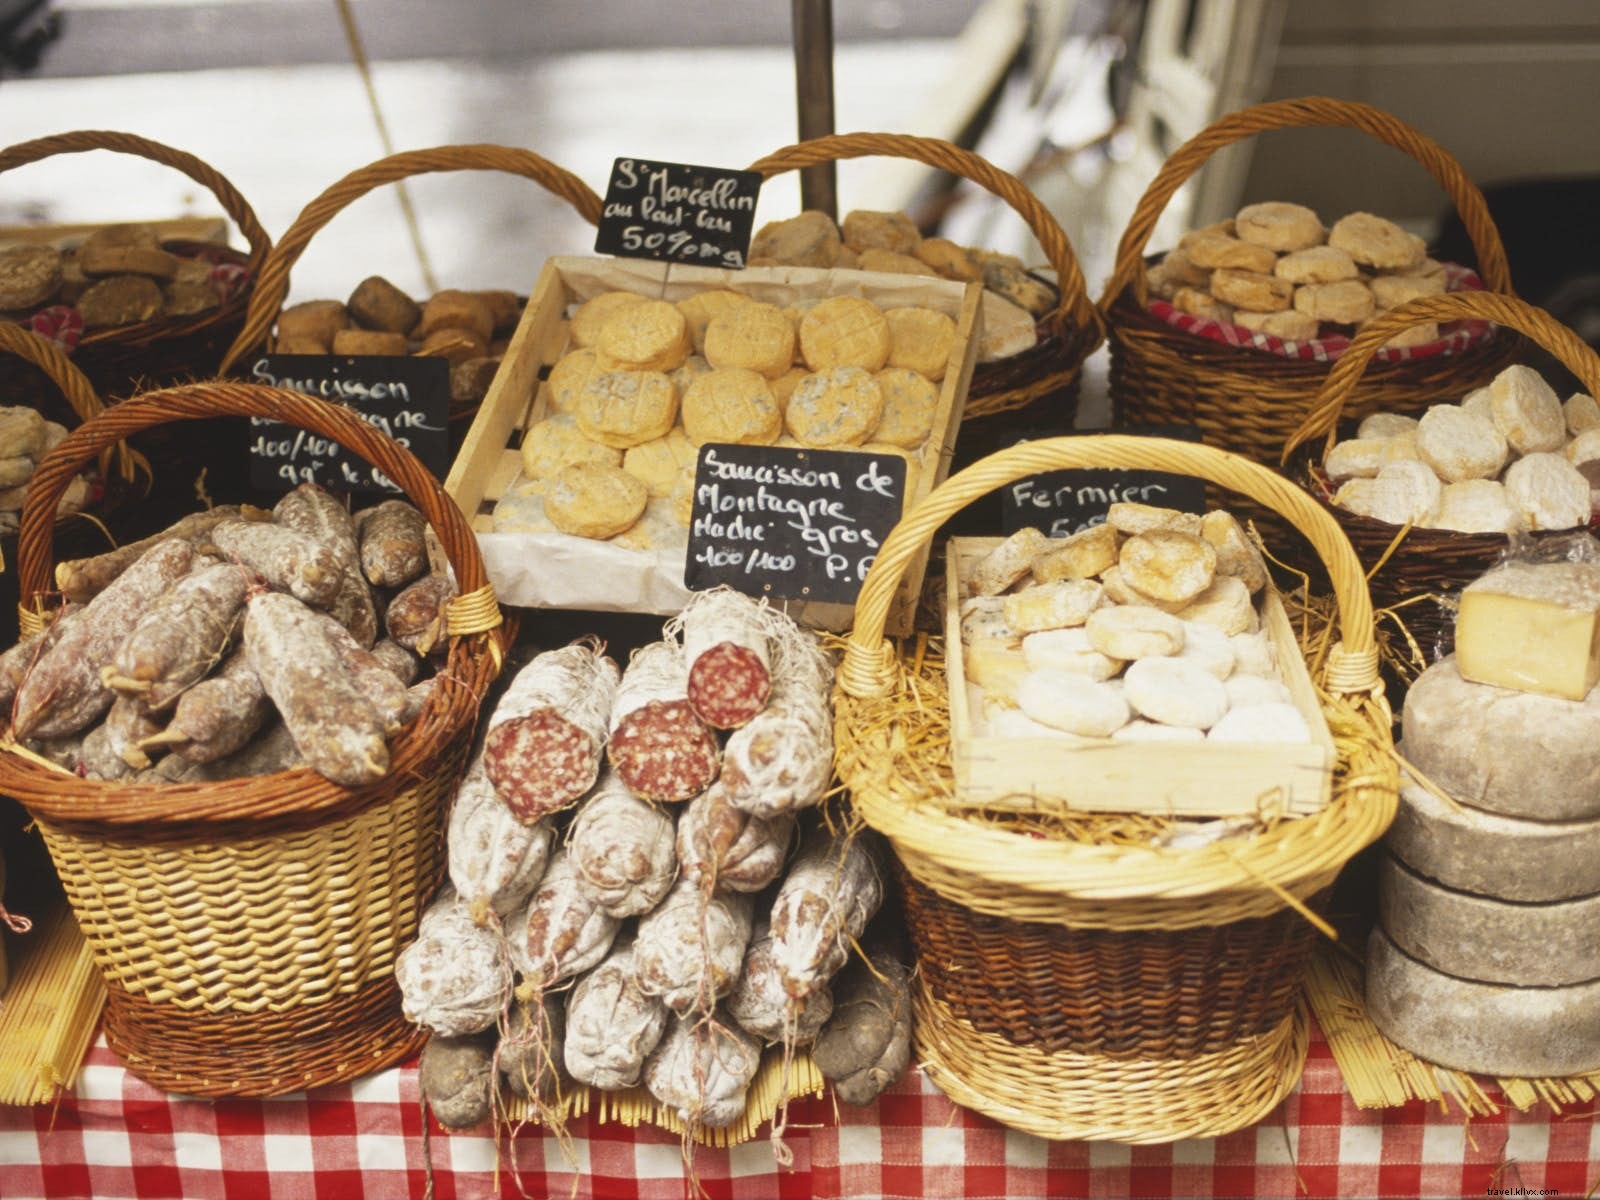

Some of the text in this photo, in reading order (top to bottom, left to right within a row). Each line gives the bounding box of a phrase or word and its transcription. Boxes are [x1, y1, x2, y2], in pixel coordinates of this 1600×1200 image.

[648, 168, 753, 211] Marcellin
[604, 202, 633, 218] au
[704, 449, 895, 498] Saucisson de
[698, 484, 856, 530] Montagne
[1012, 481, 1168, 508] Fermier
[801, 525, 879, 557] gros
[696, 546, 796, 574] 100/100
